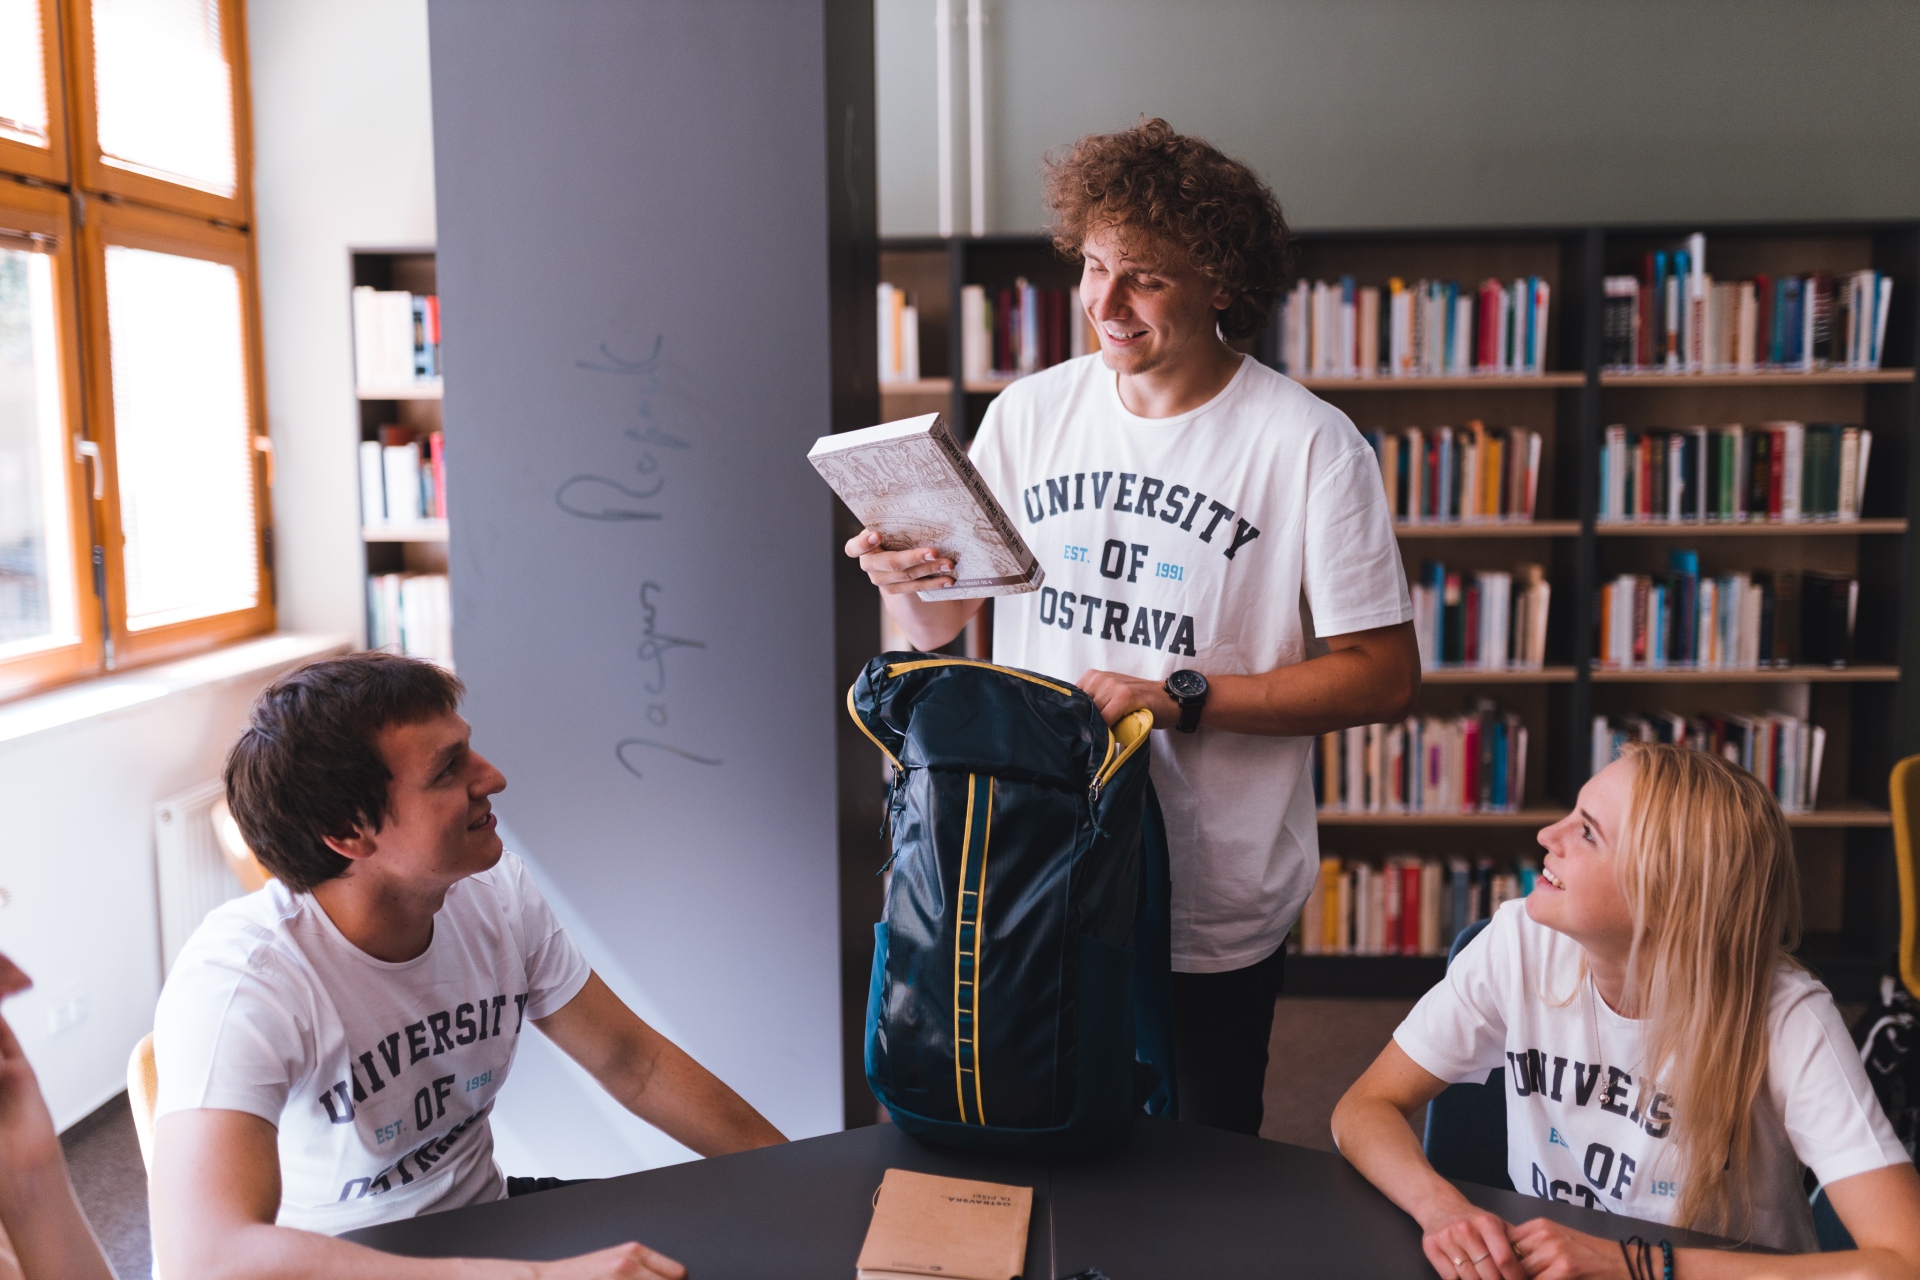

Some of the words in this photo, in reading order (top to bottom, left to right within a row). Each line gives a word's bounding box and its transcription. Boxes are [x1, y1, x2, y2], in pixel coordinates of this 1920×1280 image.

[941, 432, 961, 462] EUROPEAN
[959, 459, 974, 481] SPACE
[973, 481, 987, 503] BALTIC
[985, 499, 998, 518] SPACE
[1011, 536, 1024, 555] SPACE
[1023, 471, 1261, 561] UNIVERSITY
[1063, 545, 1091, 564] EST.
[1100, 538, 1149, 583] OF
[1155, 562, 1184, 581] 1991
[1039, 586, 1197, 657] OSTRAVA
[374, 1119, 407, 1146] EST.
[414, 1074, 456, 1131] OF
[465, 1070, 492, 1093] 1991
[1583, 1142, 1636, 1200] OF
